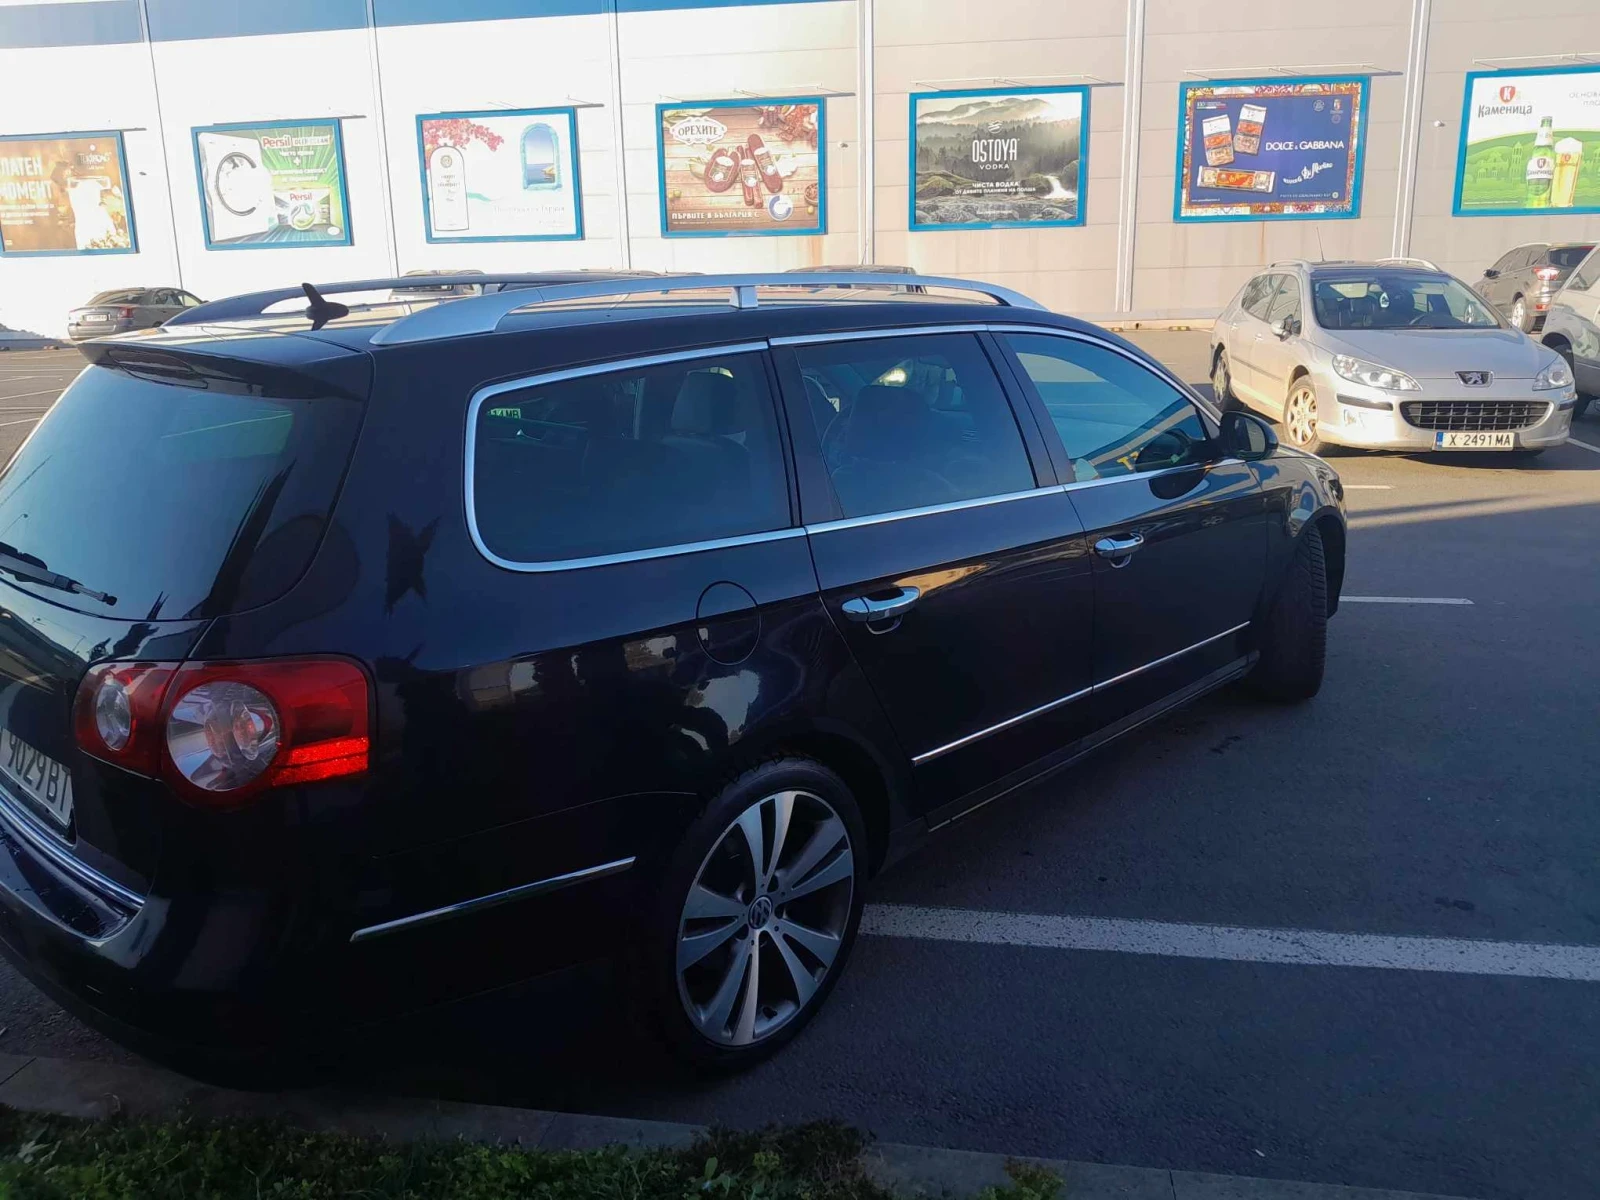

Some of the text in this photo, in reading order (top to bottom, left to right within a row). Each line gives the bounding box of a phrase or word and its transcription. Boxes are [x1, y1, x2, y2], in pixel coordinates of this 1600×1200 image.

[1478, 105, 1533, 118] Каменица
[678, 125, 718, 136] ОРЕХИТЕ
[263, 136, 291, 147] Persil
[1265, 141, 1294, 151] DOLCE
[1299, 140, 1344, 150] GABBANA
[972, 138, 1017, 163] OSTOYA
[290, 192, 313, 201] Persil
[671, 212, 705, 220] ПЪРВИТЕ
[714, 211, 753, 219] БЪЛГАРИЯ
[1449, 434, 1510, 446] X 2491 MA
